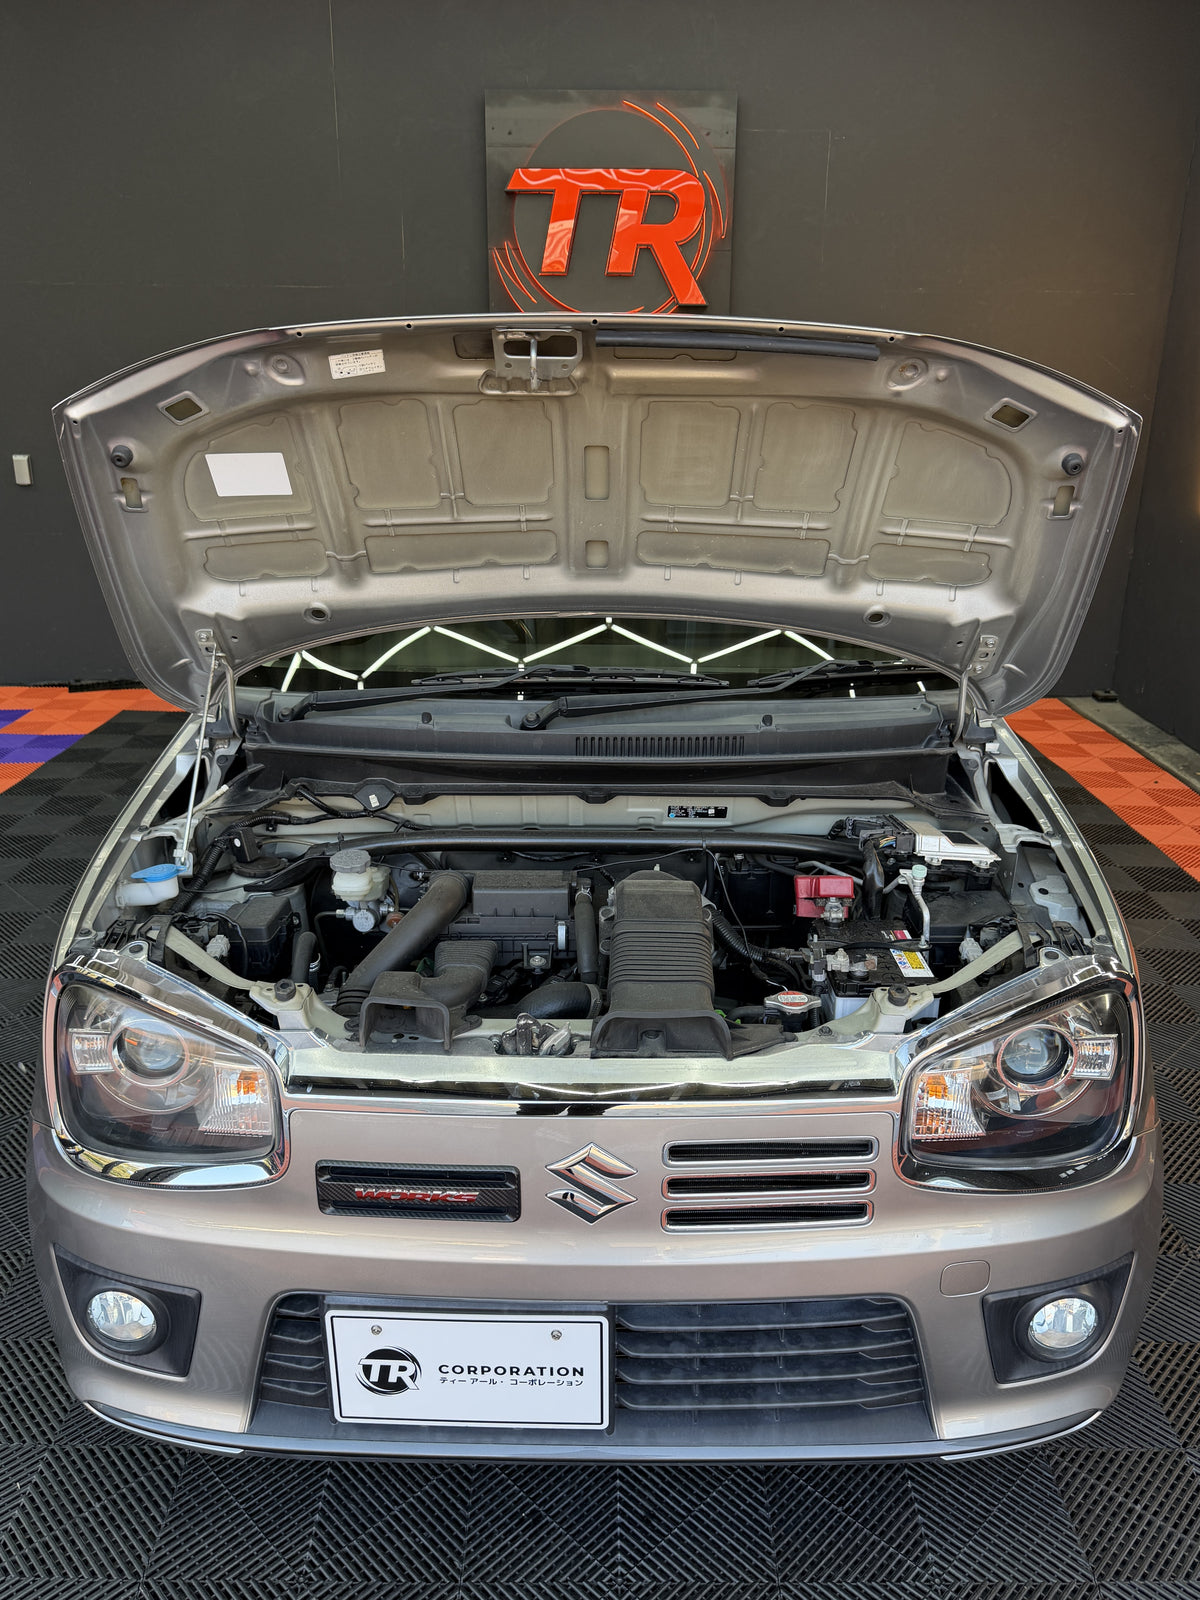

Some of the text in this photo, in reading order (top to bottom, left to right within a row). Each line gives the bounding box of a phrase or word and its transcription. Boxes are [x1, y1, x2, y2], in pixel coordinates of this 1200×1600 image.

[505, 168, 708, 307] TR
[355, 1188, 479, 1203] WORKS
[358, 1358, 420, 1391] TR
[438, 1364, 584, 1377] CORPORATION
[510, 1379, 583, 1387] コーポレーション
